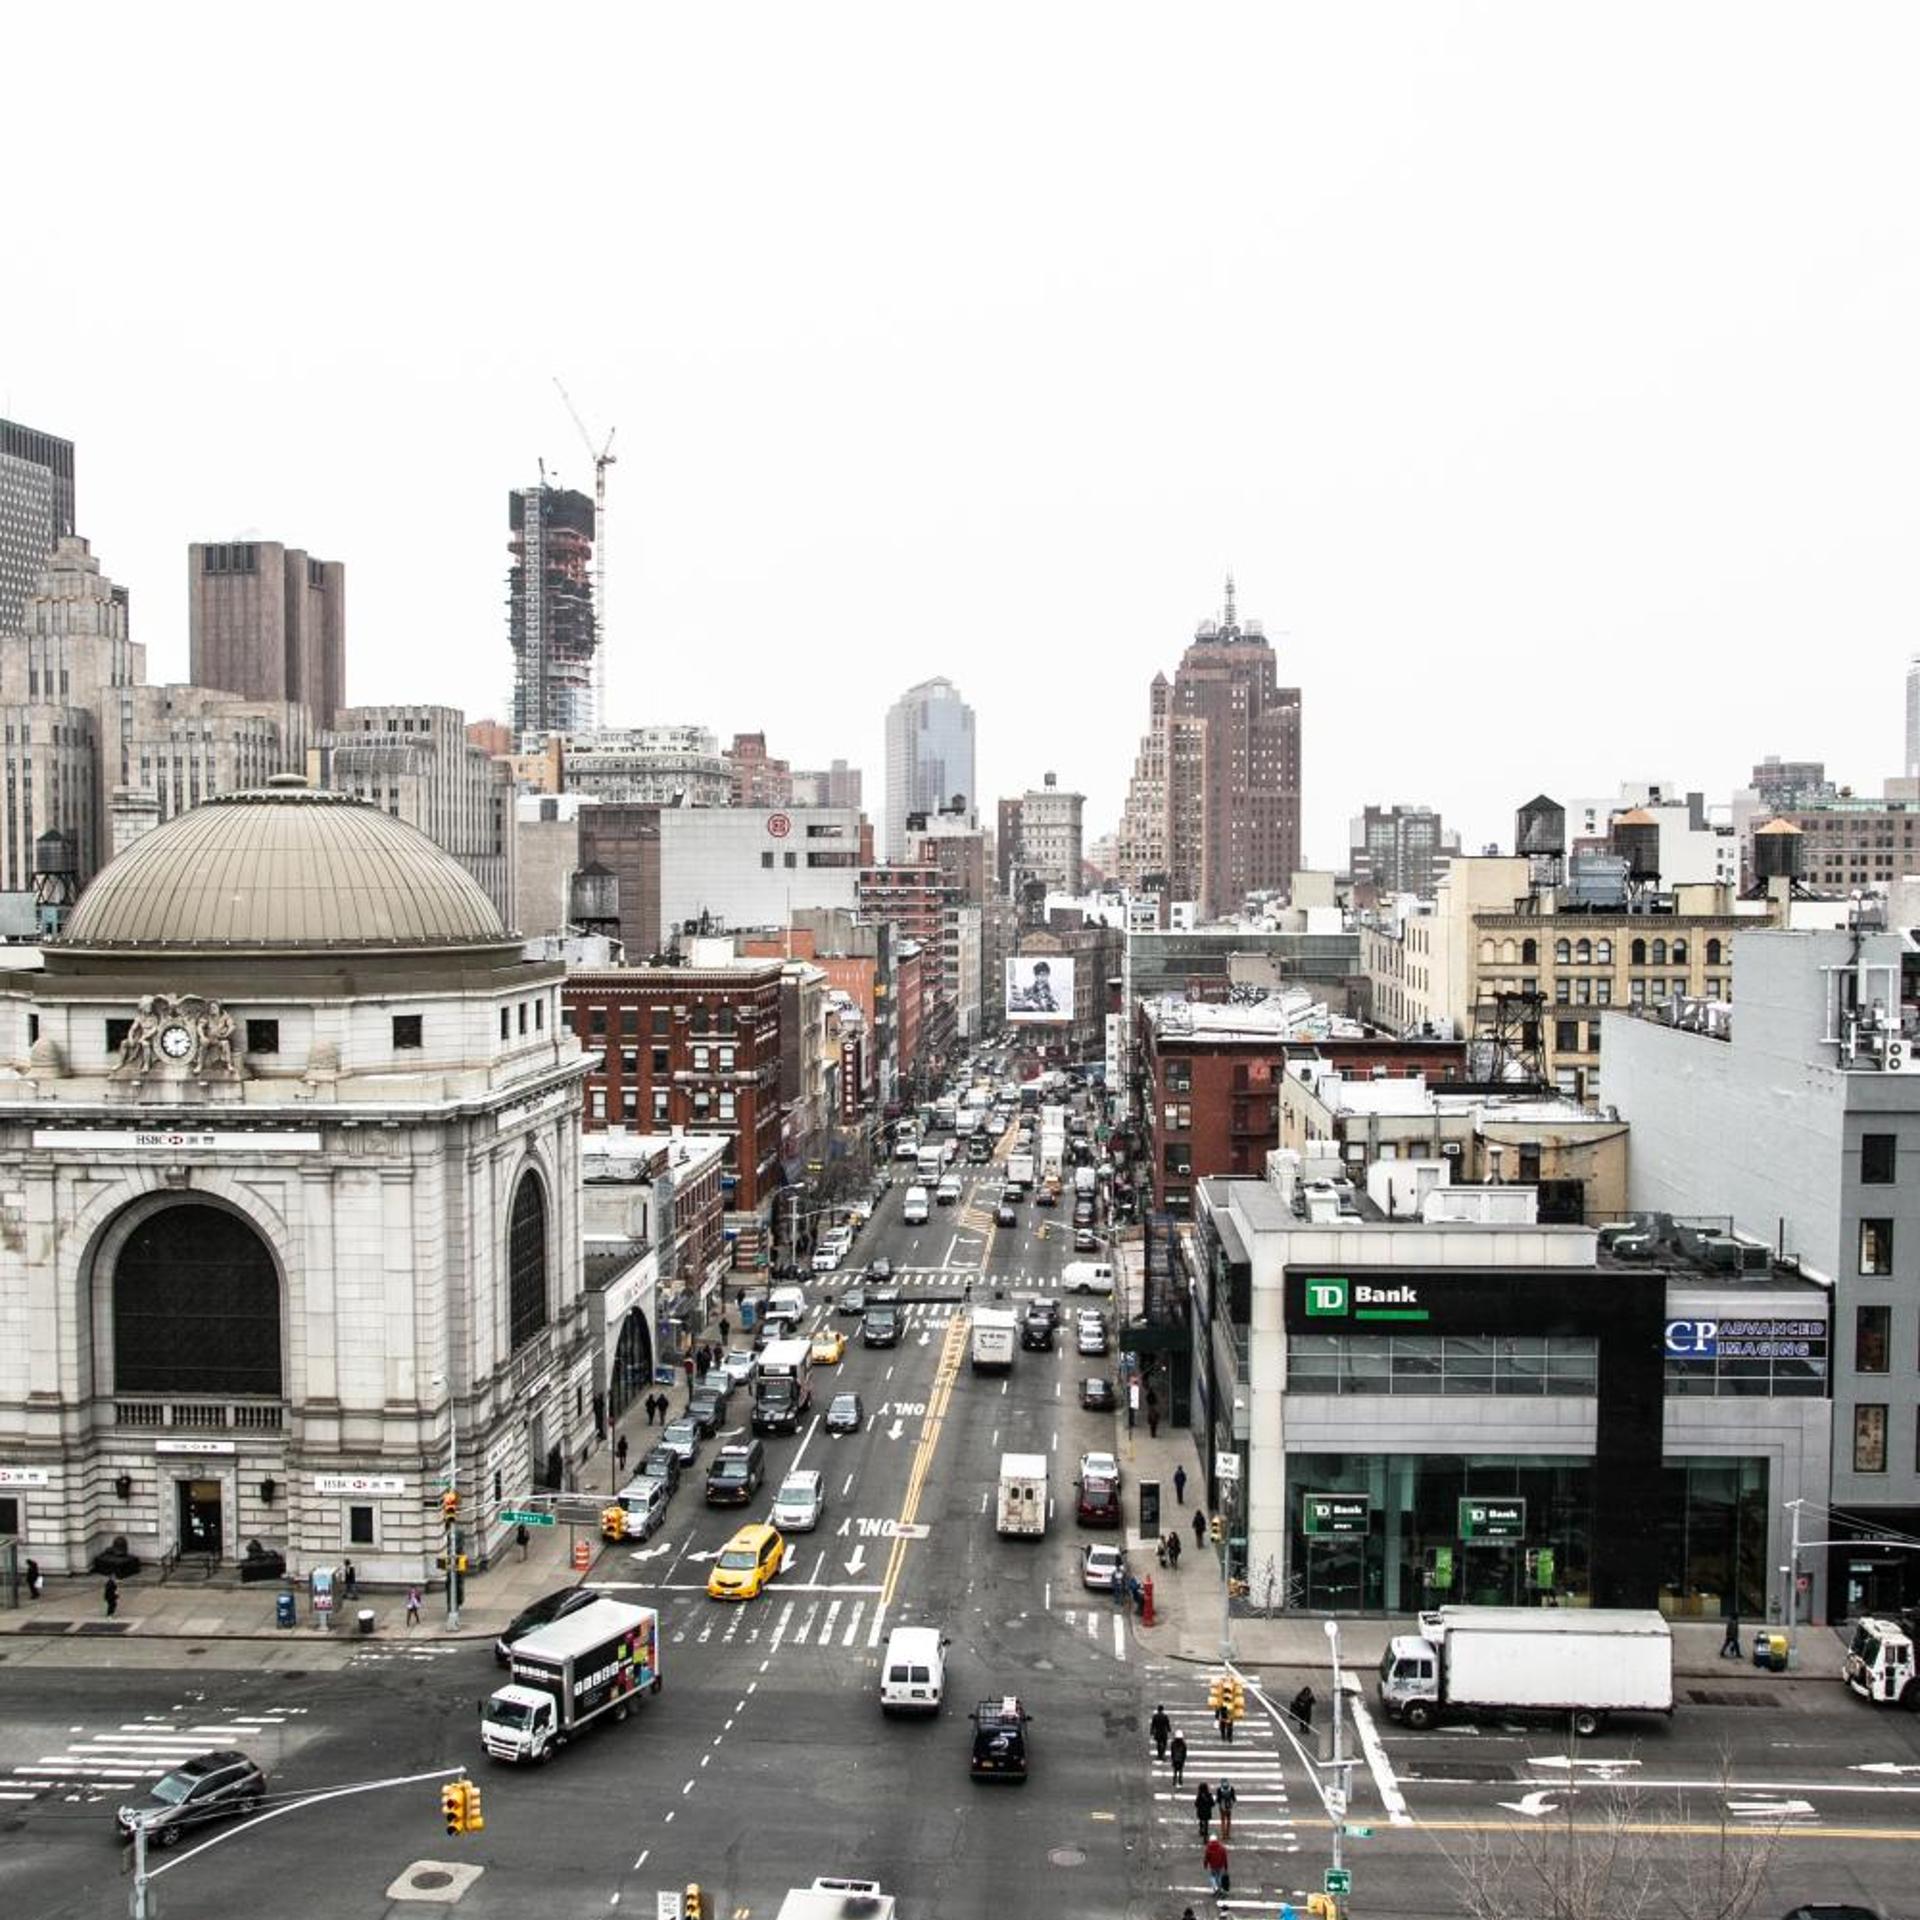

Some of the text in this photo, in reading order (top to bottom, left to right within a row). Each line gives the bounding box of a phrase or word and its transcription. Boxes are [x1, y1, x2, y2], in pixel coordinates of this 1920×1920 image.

[136, 1134, 167, 1145] HSBC
[1311, 1286, 1417, 1308] TD Bank
[1718, 1321, 1825, 1336] ADVANCED
[1665, 1321, 1717, 1351] CP
[1718, 1342, 1810, 1356] IMAGING
[878, 1402, 926, 1416] ONLY
[1315, 1504, 1362, 1516] TD Bank
[1489, 1509, 1518, 1518] Bank
[837, 1517, 898, 1537] ONLY
